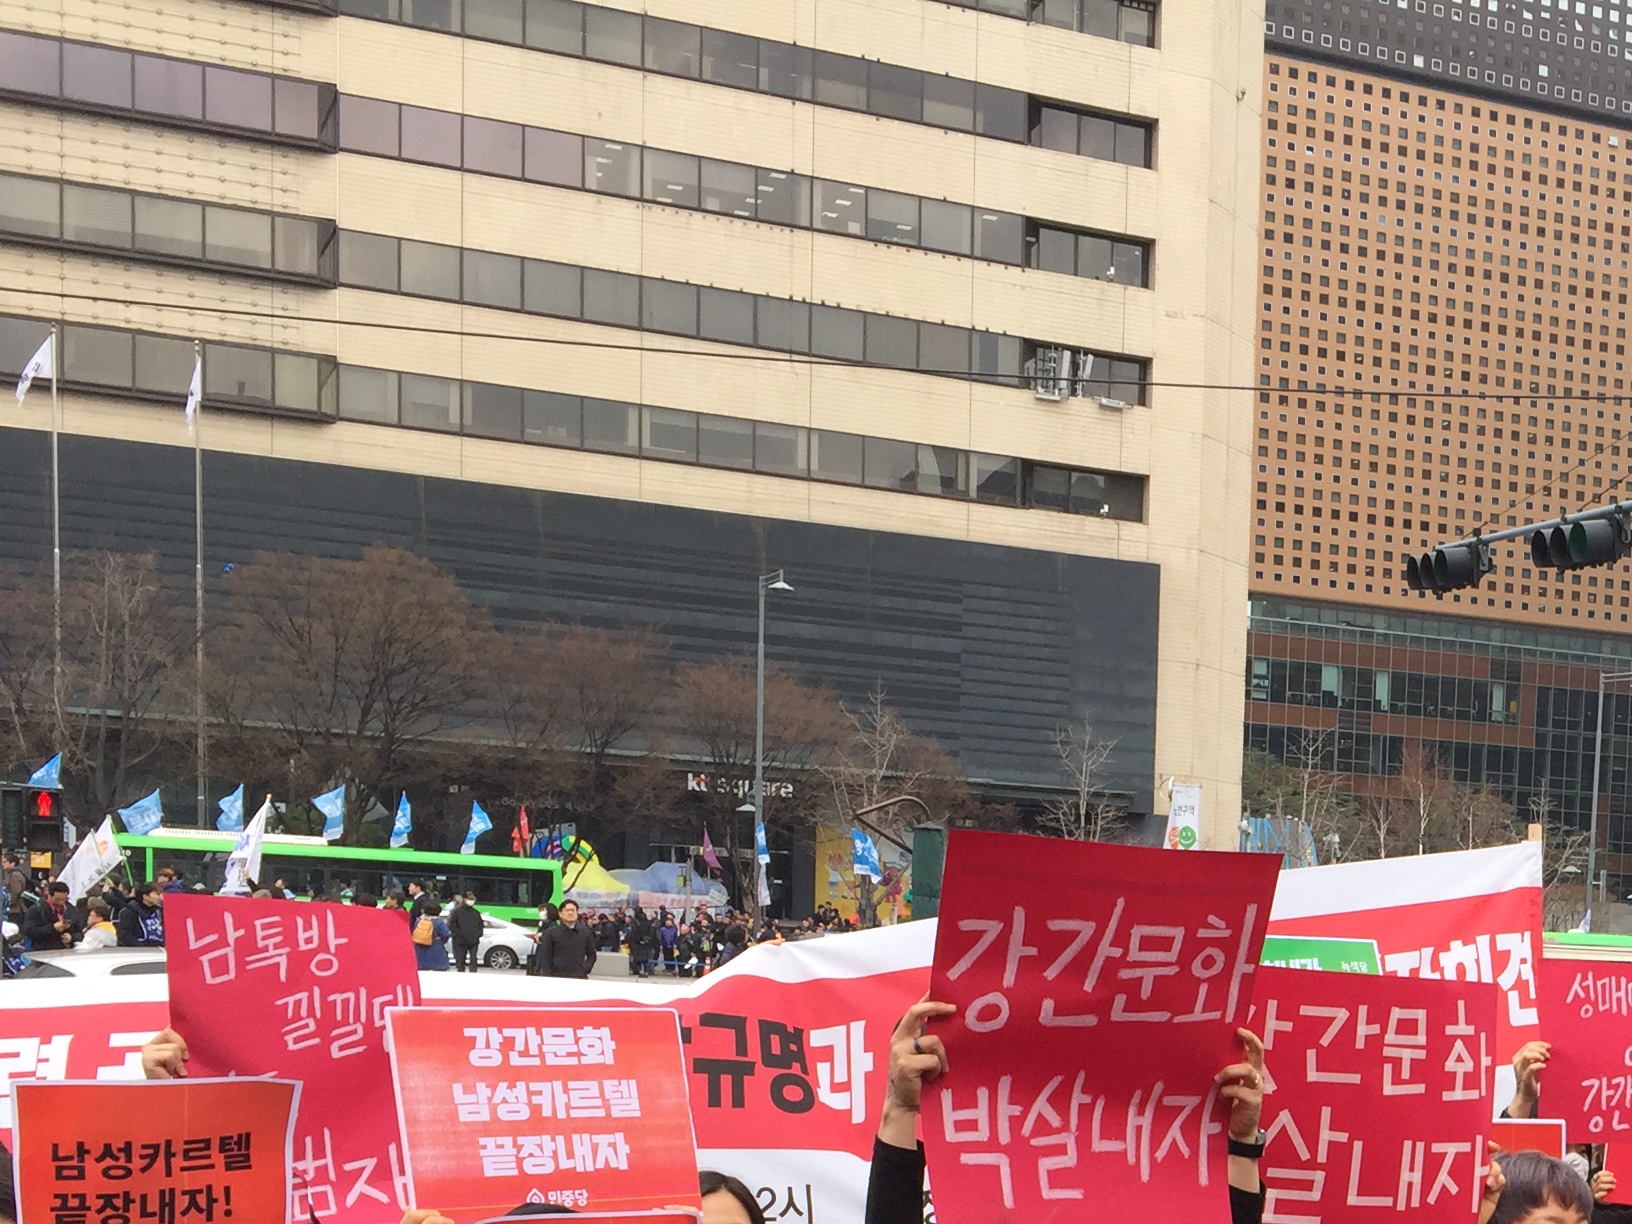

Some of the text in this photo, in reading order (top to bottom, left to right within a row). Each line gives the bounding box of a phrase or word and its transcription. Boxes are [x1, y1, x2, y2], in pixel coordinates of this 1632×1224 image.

[186, 911, 348, 986] 남톡방
[947, 897, 1257, 1033] 강간문화
[463, 1027, 616, 1067] 강간문화
[683, 1012, 874, 1124] 규명과
[452, 1079, 642, 1122] 남성카르텔
[50, 1132, 253, 1182] 남성카르텔
[479, 1132, 630, 1177] 끝장내자
[941, 1068, 1226, 1209] 박살내자
[547, 1188, 589, 1206] 민중당
